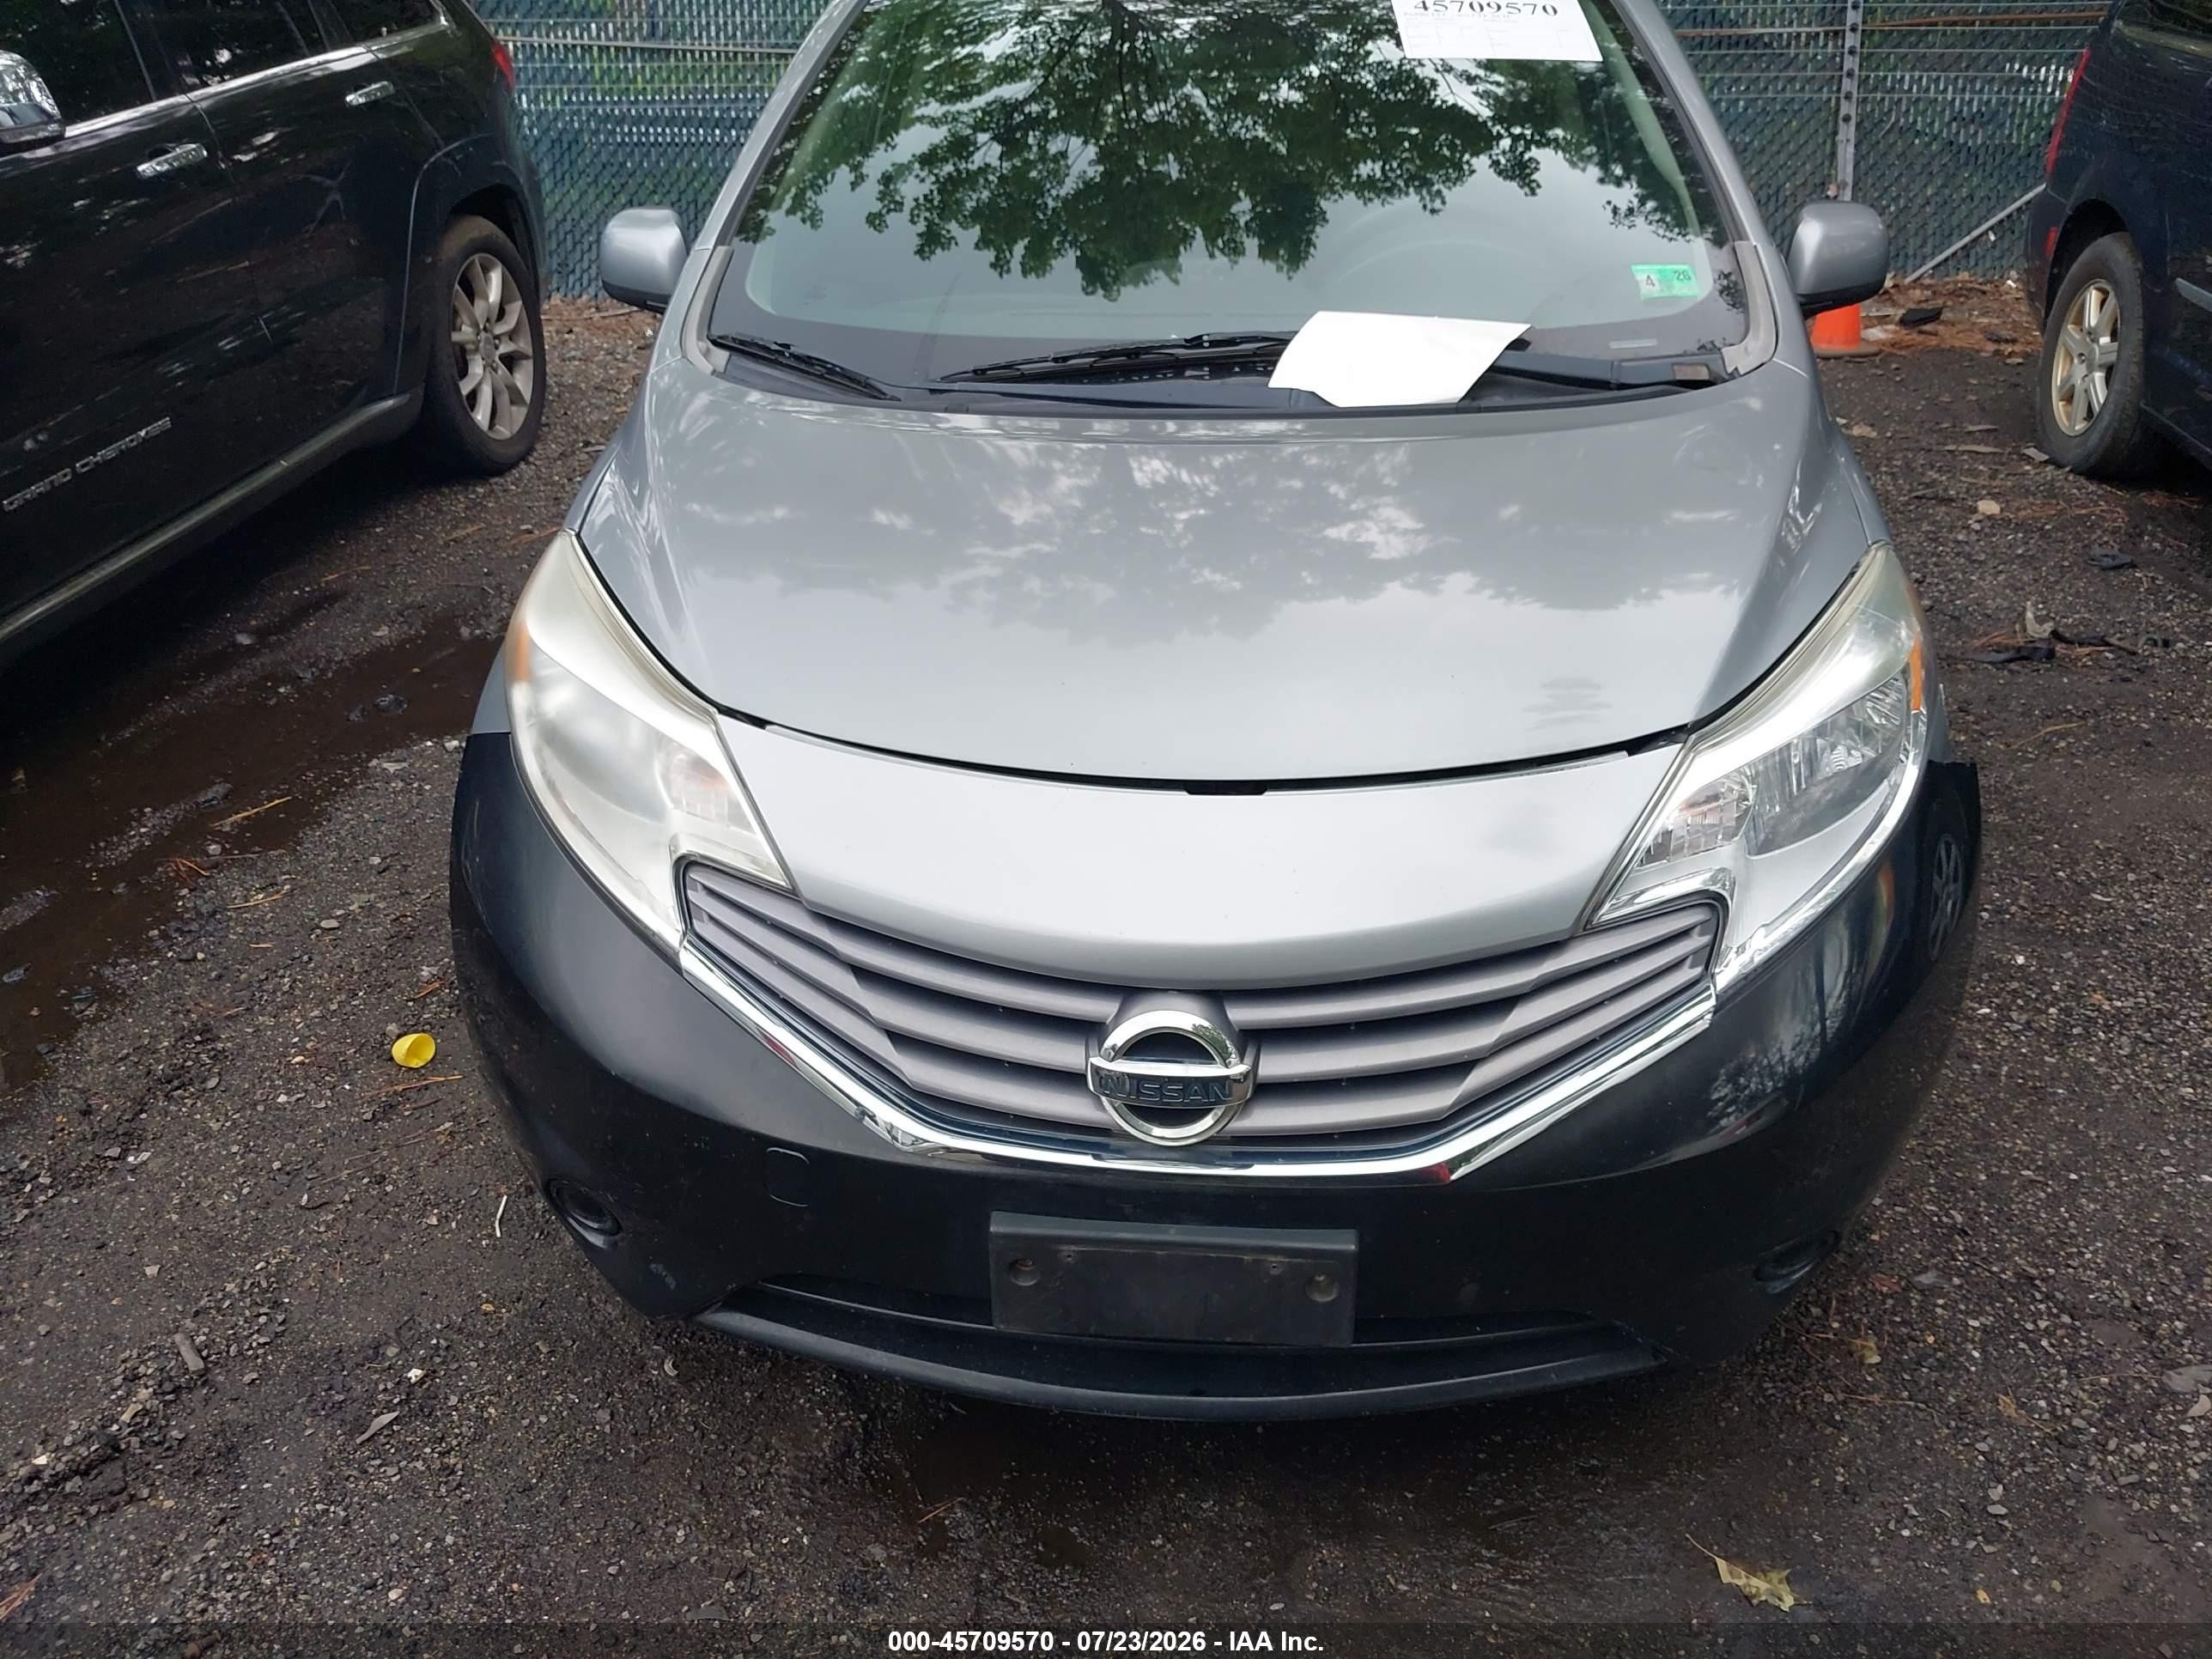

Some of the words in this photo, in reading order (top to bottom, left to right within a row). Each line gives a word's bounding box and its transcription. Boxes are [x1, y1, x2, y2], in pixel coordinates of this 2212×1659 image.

[1414, 0, 1559, 16] 45709570
[1645, 275, 1656, 288] 4
[3, 469, 72, 512] GRAND
[76, 417, 172, 473] CHEROKEE
[1099, 1077, 1233, 1103] NISSAN
